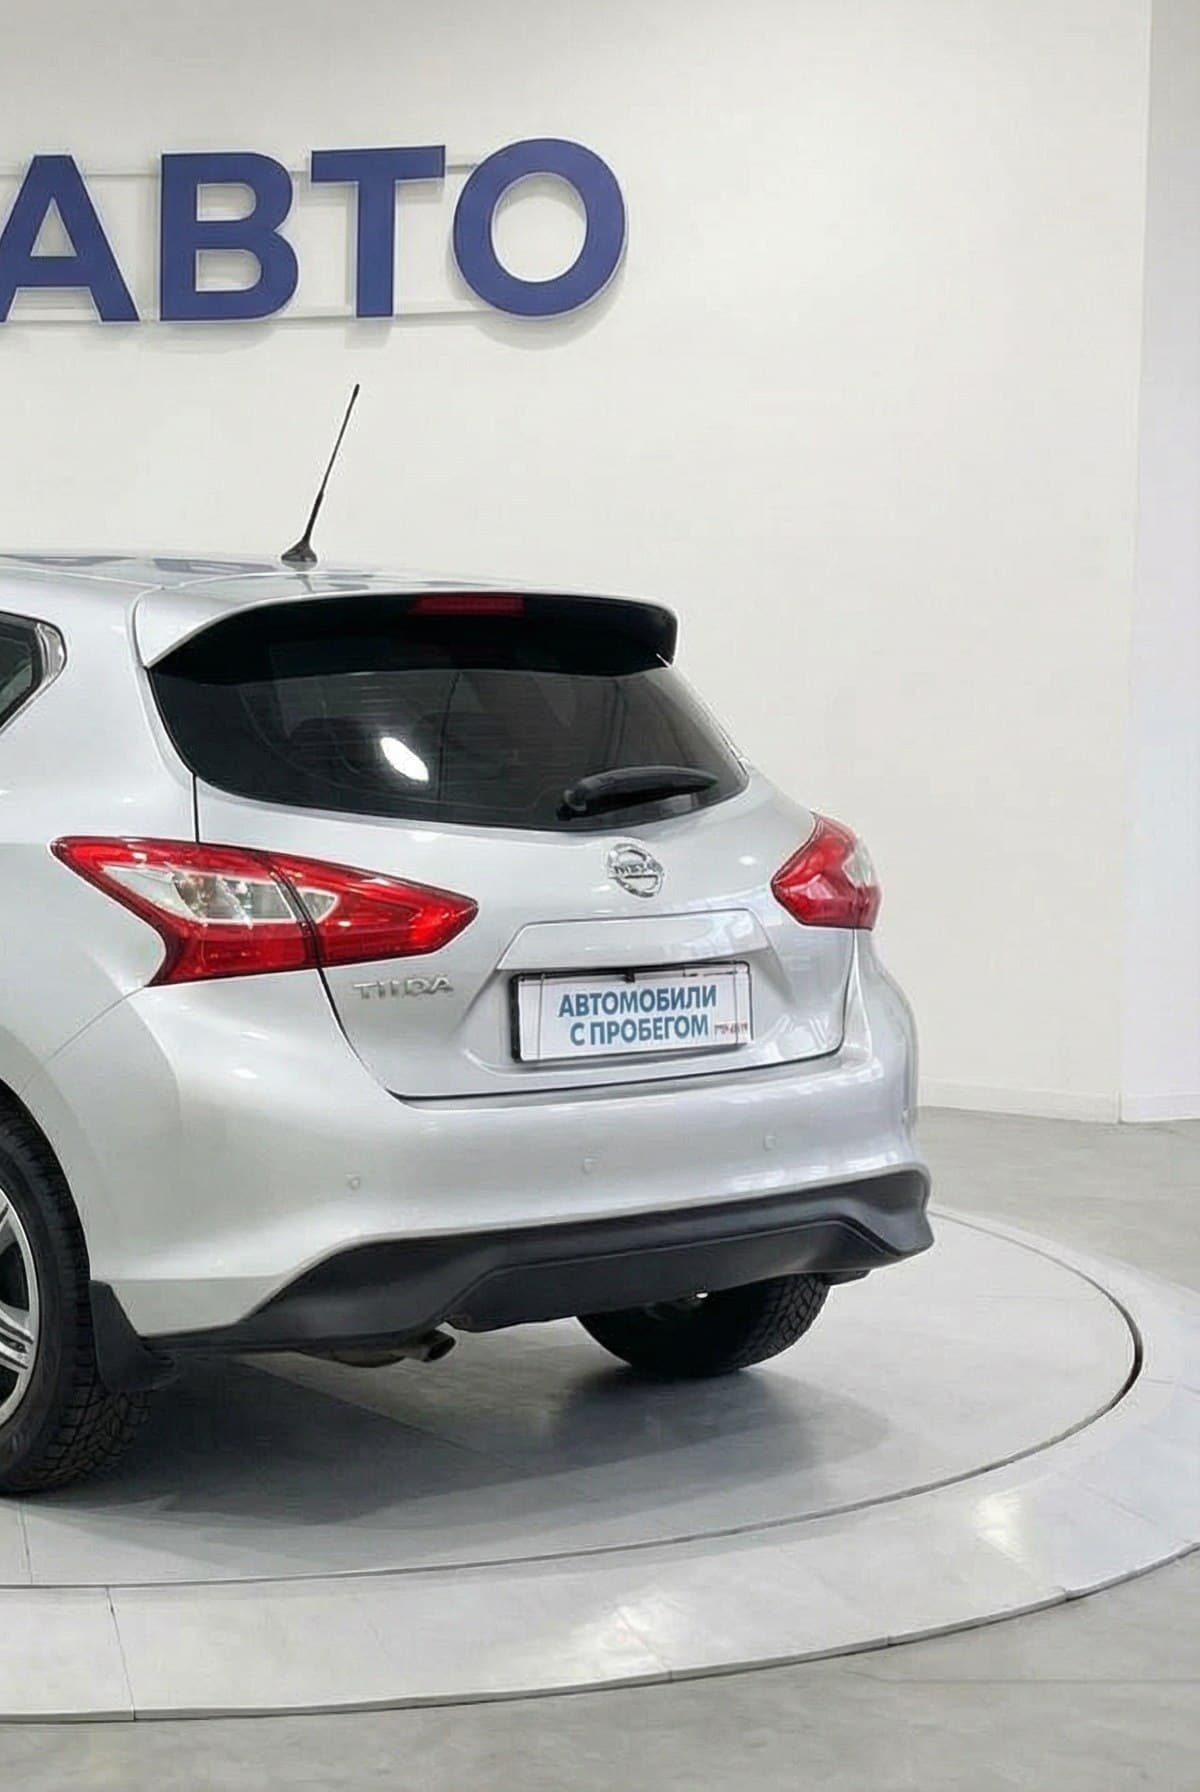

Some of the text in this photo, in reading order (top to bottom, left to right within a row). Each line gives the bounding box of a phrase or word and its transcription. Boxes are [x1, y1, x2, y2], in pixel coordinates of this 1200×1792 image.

[352, 976, 453, 999] TIIDA
[558, 984, 717, 1018] АВТОМОБИЛИ
[569, 1022, 585, 1046] С
[590, 1014, 709, 1046] ПРОБЕГОМ
